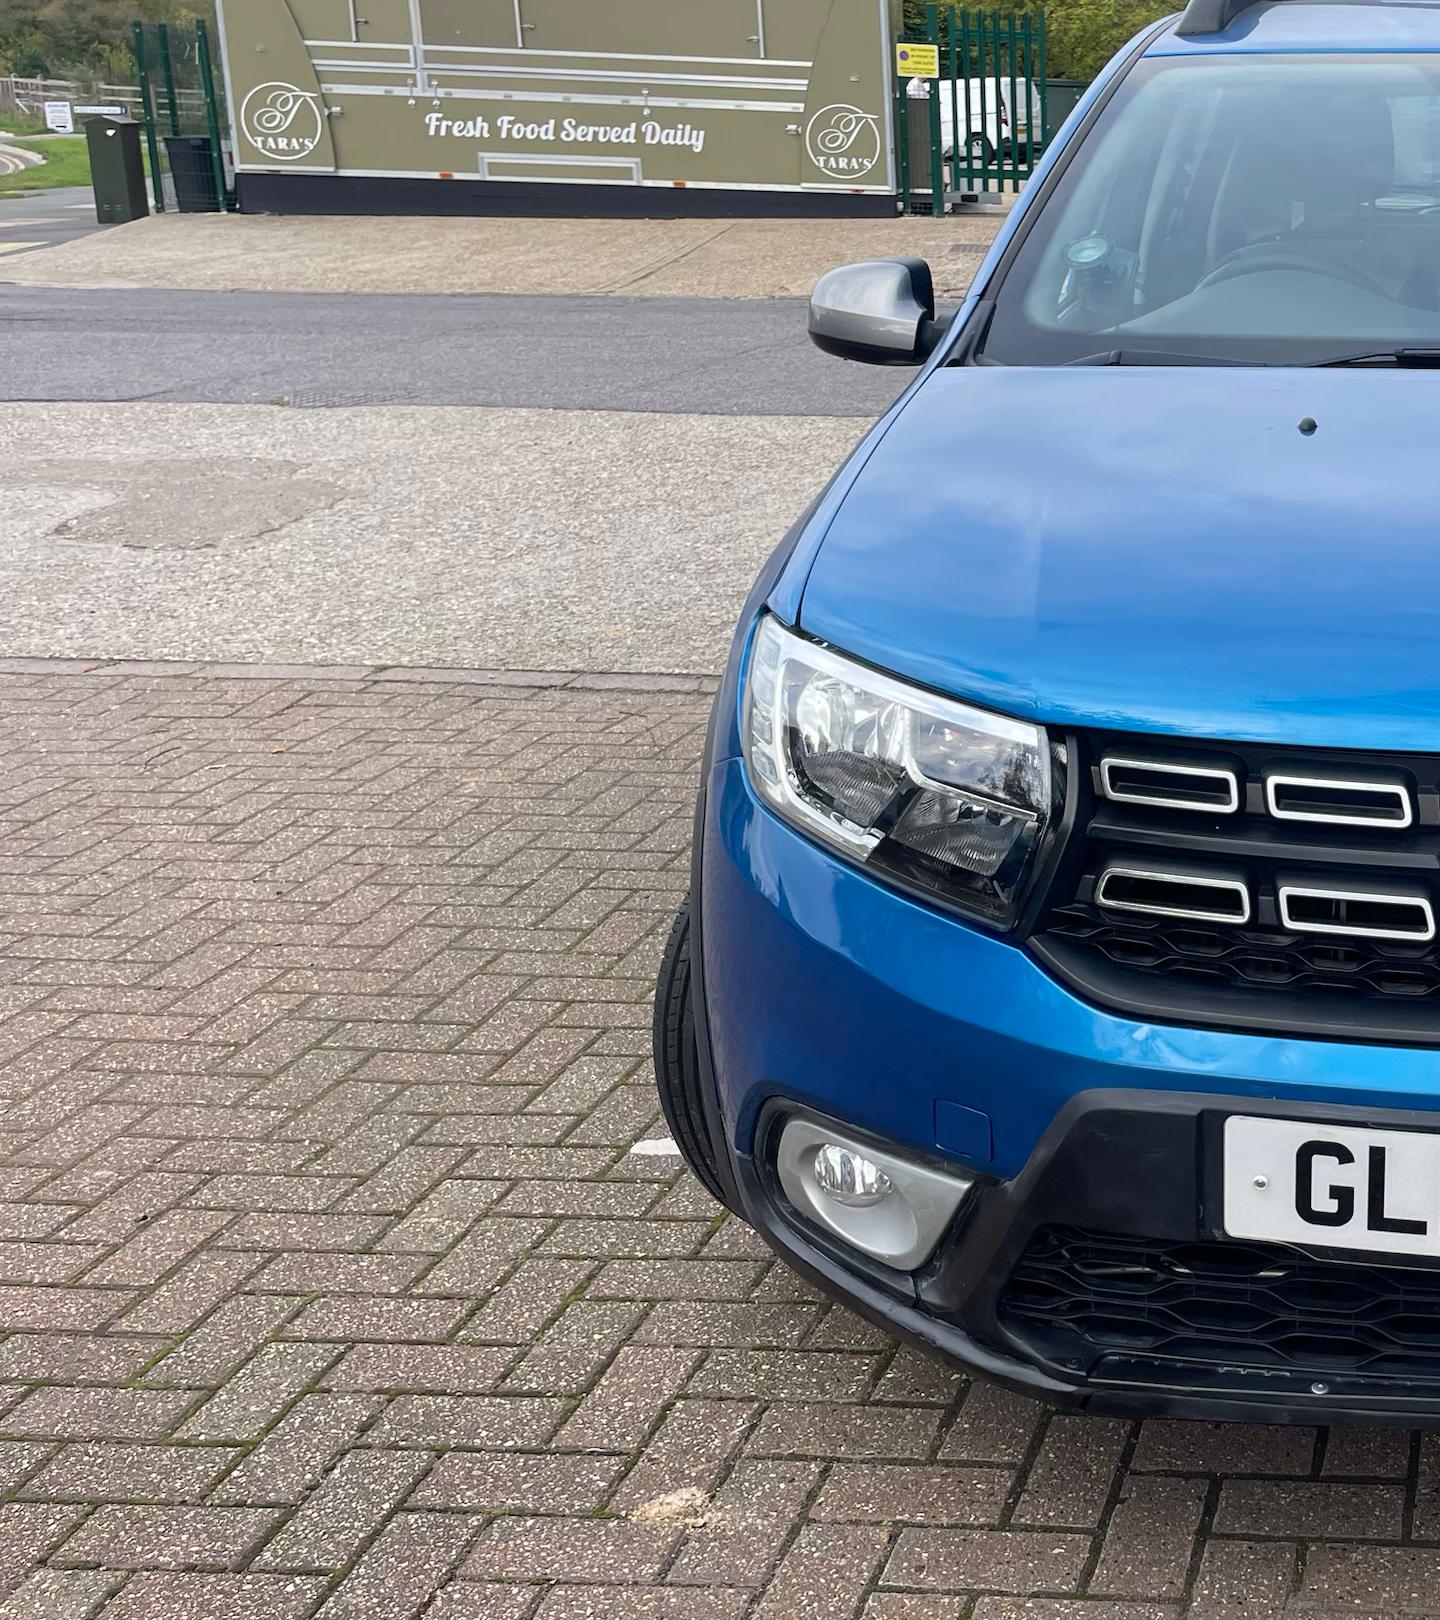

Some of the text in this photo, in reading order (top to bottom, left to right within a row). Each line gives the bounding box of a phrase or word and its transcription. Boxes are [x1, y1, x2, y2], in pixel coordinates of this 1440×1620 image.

[425, 112, 705, 153] Fresh Food Served Daily
[254, 136, 314, 151] TARA'S
[816, 156, 873, 171] TARA'S
